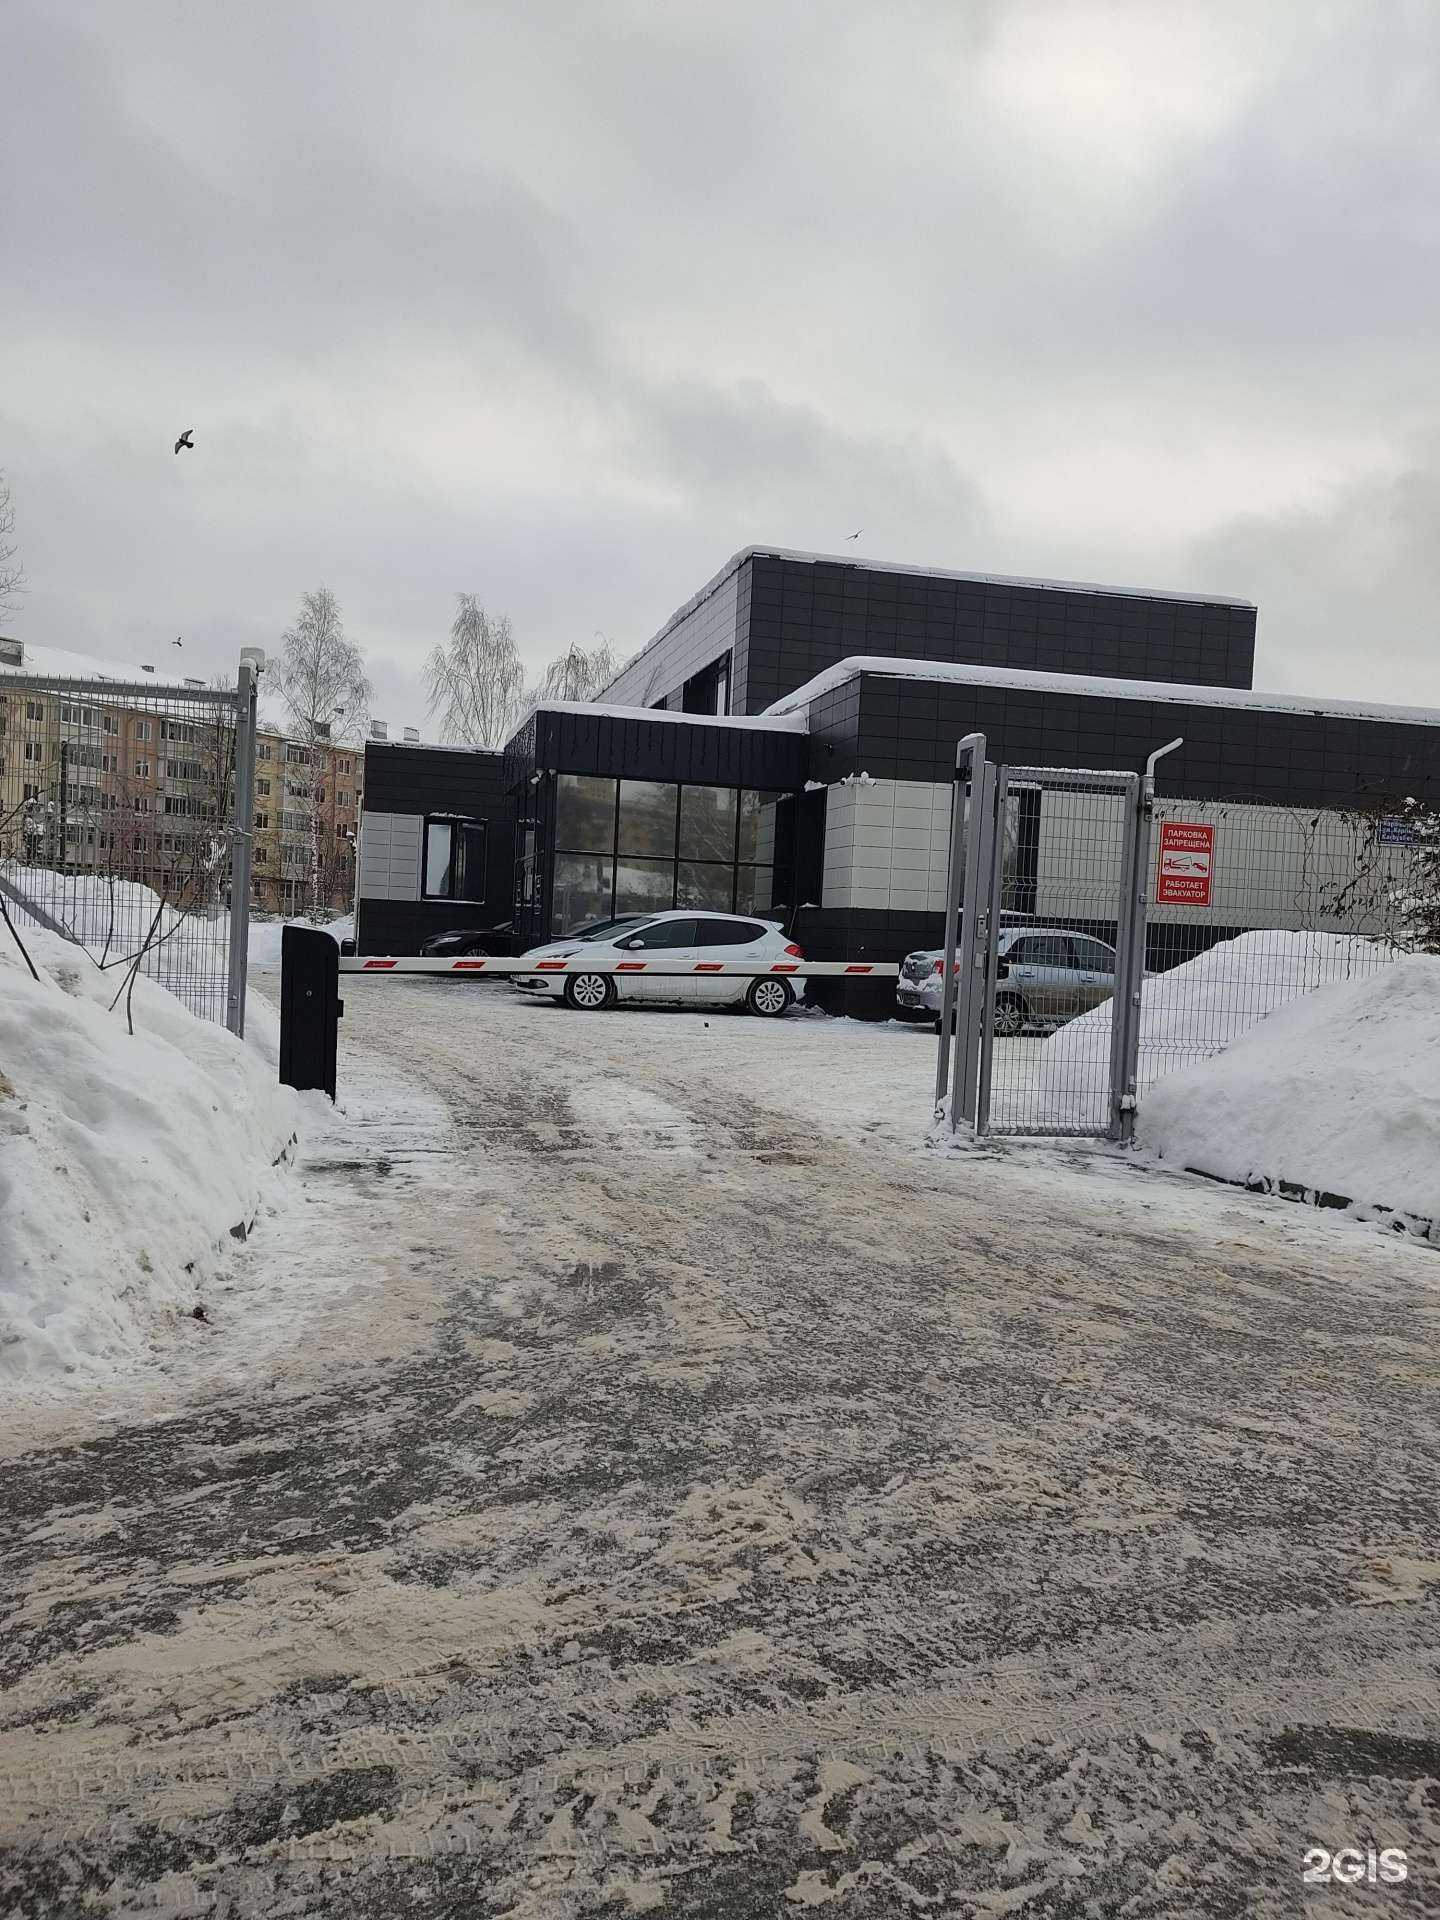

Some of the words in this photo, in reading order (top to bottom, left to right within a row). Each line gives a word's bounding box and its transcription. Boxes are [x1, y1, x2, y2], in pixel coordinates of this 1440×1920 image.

[1168, 829, 1207, 839] ПАРКОВКА
[1164, 838, 1210, 848] ЗАПРЕЩЕНА
[1165, 880, 1204, 890] РАБОТАЕТ
[1163, 888, 1206, 899] ЭВАКУАТОР
